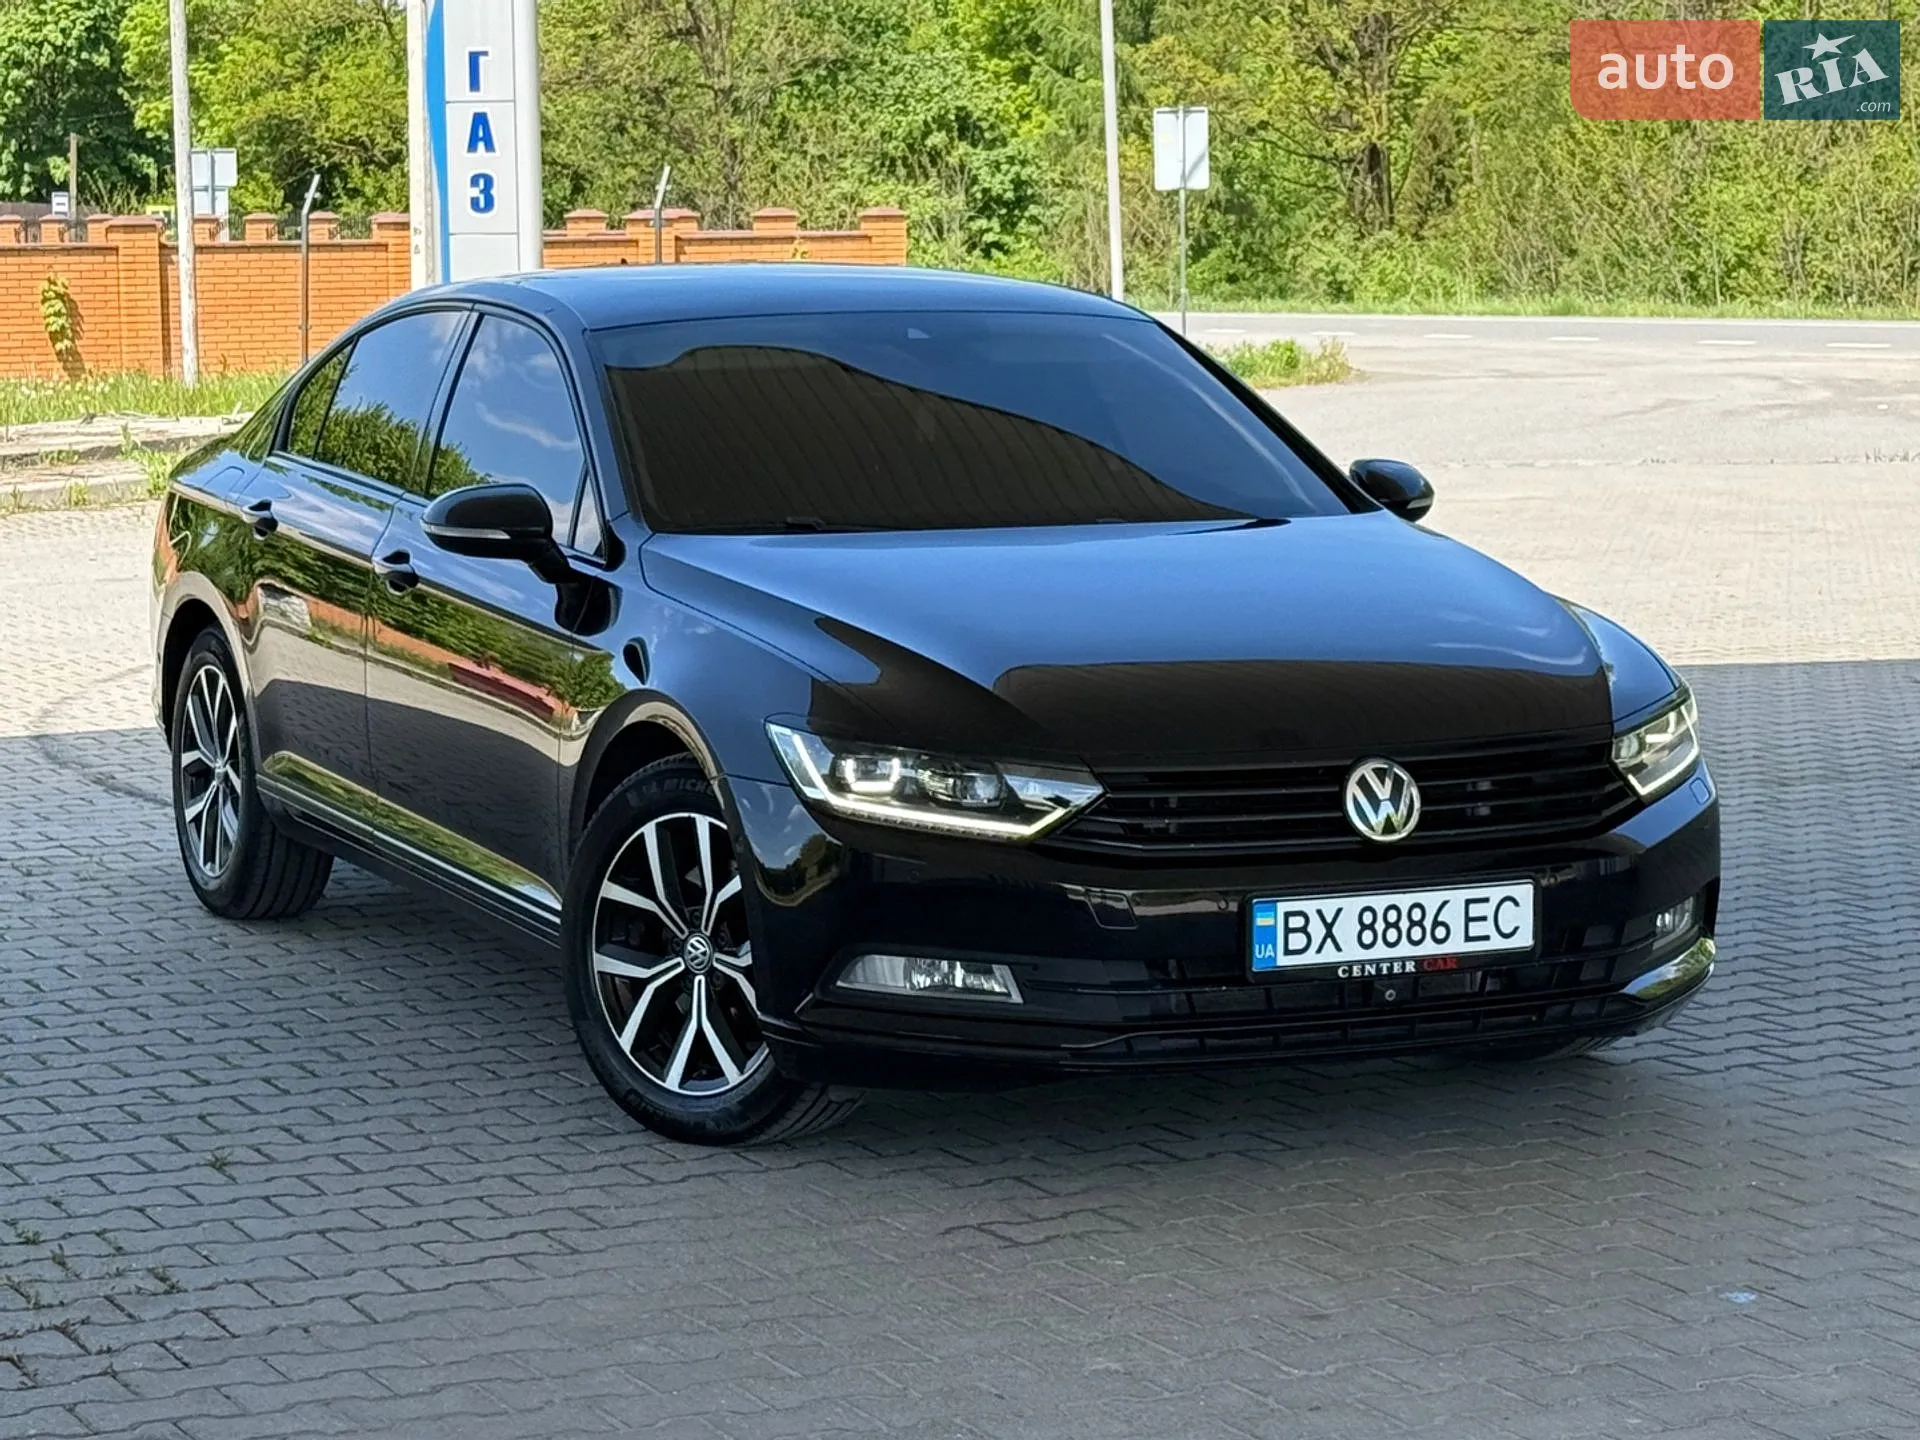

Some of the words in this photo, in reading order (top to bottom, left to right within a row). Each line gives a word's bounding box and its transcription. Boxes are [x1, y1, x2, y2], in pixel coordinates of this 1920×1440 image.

[466, 50, 496, 214] ГАЗ
[1282, 907, 1344, 957] BX
[1356, 899, 1451, 950] 8886
[1463, 895, 1521, 943] EC
[1255, 943, 1275, 959] UA
[1337, 960, 1417, 979] CENTER
